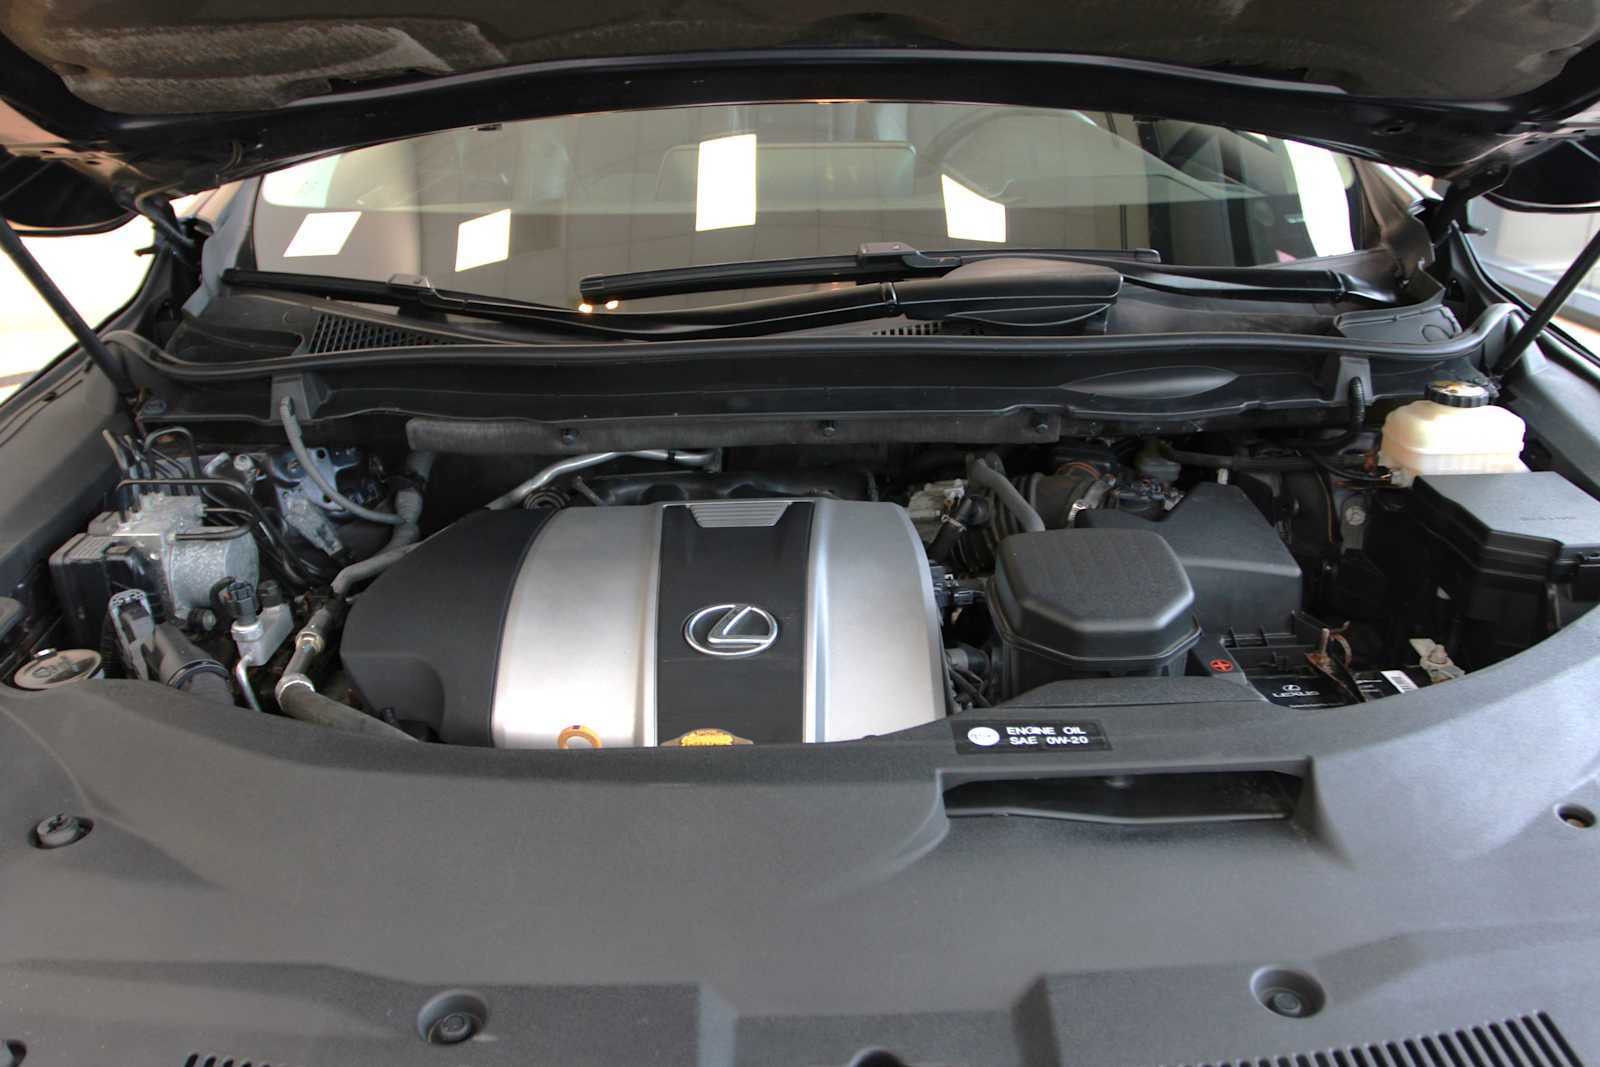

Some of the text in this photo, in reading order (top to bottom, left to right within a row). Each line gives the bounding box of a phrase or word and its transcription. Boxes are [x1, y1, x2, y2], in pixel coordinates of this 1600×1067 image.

[1005, 726, 1087, 735] ENGINE OIL
[1009, 736, 1089, 745] SAE 0W-20
